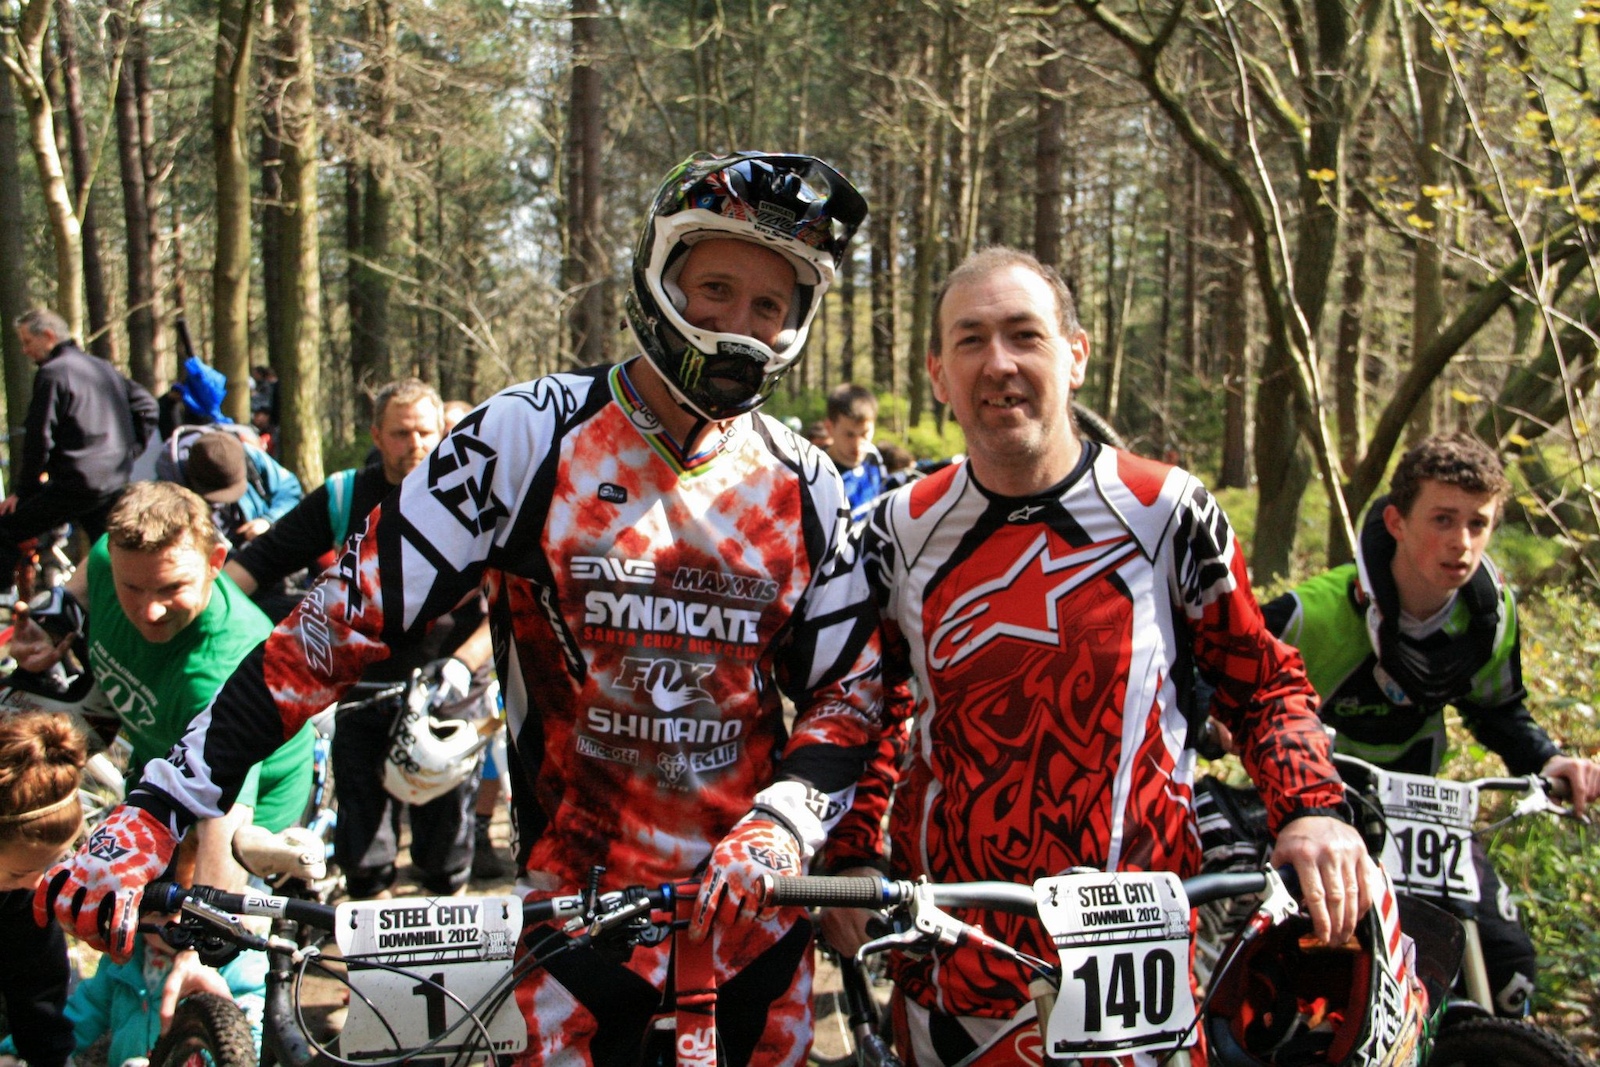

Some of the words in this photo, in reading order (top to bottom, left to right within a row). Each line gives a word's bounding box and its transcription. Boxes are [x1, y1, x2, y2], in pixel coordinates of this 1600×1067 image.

[640, 406, 657, 425] UCI
[672, 566, 780, 602] MAXXIS
[584, 590, 762, 643] SYNDICATE
[583, 626, 637, 648] SANTA
[643, 633, 684, 650] CRUZ
[611, 656, 716, 704] FOX
[587, 706, 743, 743] SHIMANO
[1407, 783, 1436, 799] STEEL
[1440, 788, 1460, 803] CITY
[1444, 805, 1459, 816] 2012
[1395, 827, 1464, 881] 192
[1078, 884, 1122, 908] STEEL
[1124, 882, 1156, 905] CITY
[379, 907, 432, 930] STEEL
[436, 904, 479, 926] CITY
[1082, 909, 1135, 927] DOWNHILL
[1136, 907, 1161, 922] 2012
[379, 929, 446, 949] DOWNHILL
[448, 928, 479, 944] 2012
[1073, 948, 1175, 1033] 140
[412, 971, 447, 1040] 1
